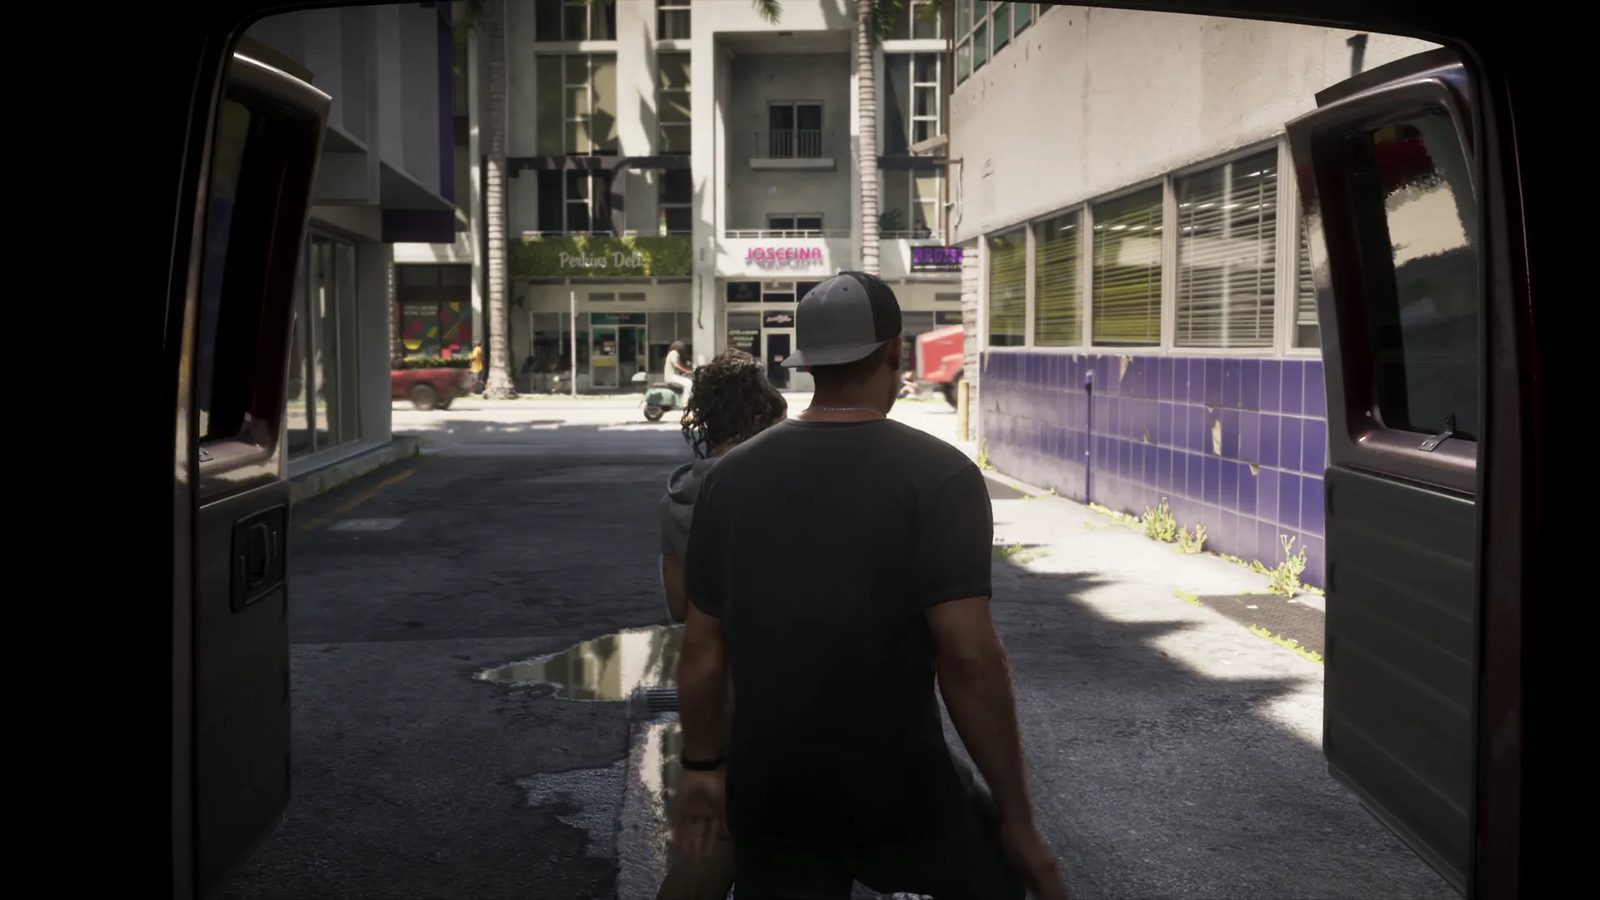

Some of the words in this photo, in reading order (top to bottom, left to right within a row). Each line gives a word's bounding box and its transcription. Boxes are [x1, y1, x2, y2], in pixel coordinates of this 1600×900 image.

[559, 252, 607, 268] Perkins
[612, 251, 643, 268] Deli
[745, 247, 822, 260] JOSEFINA
